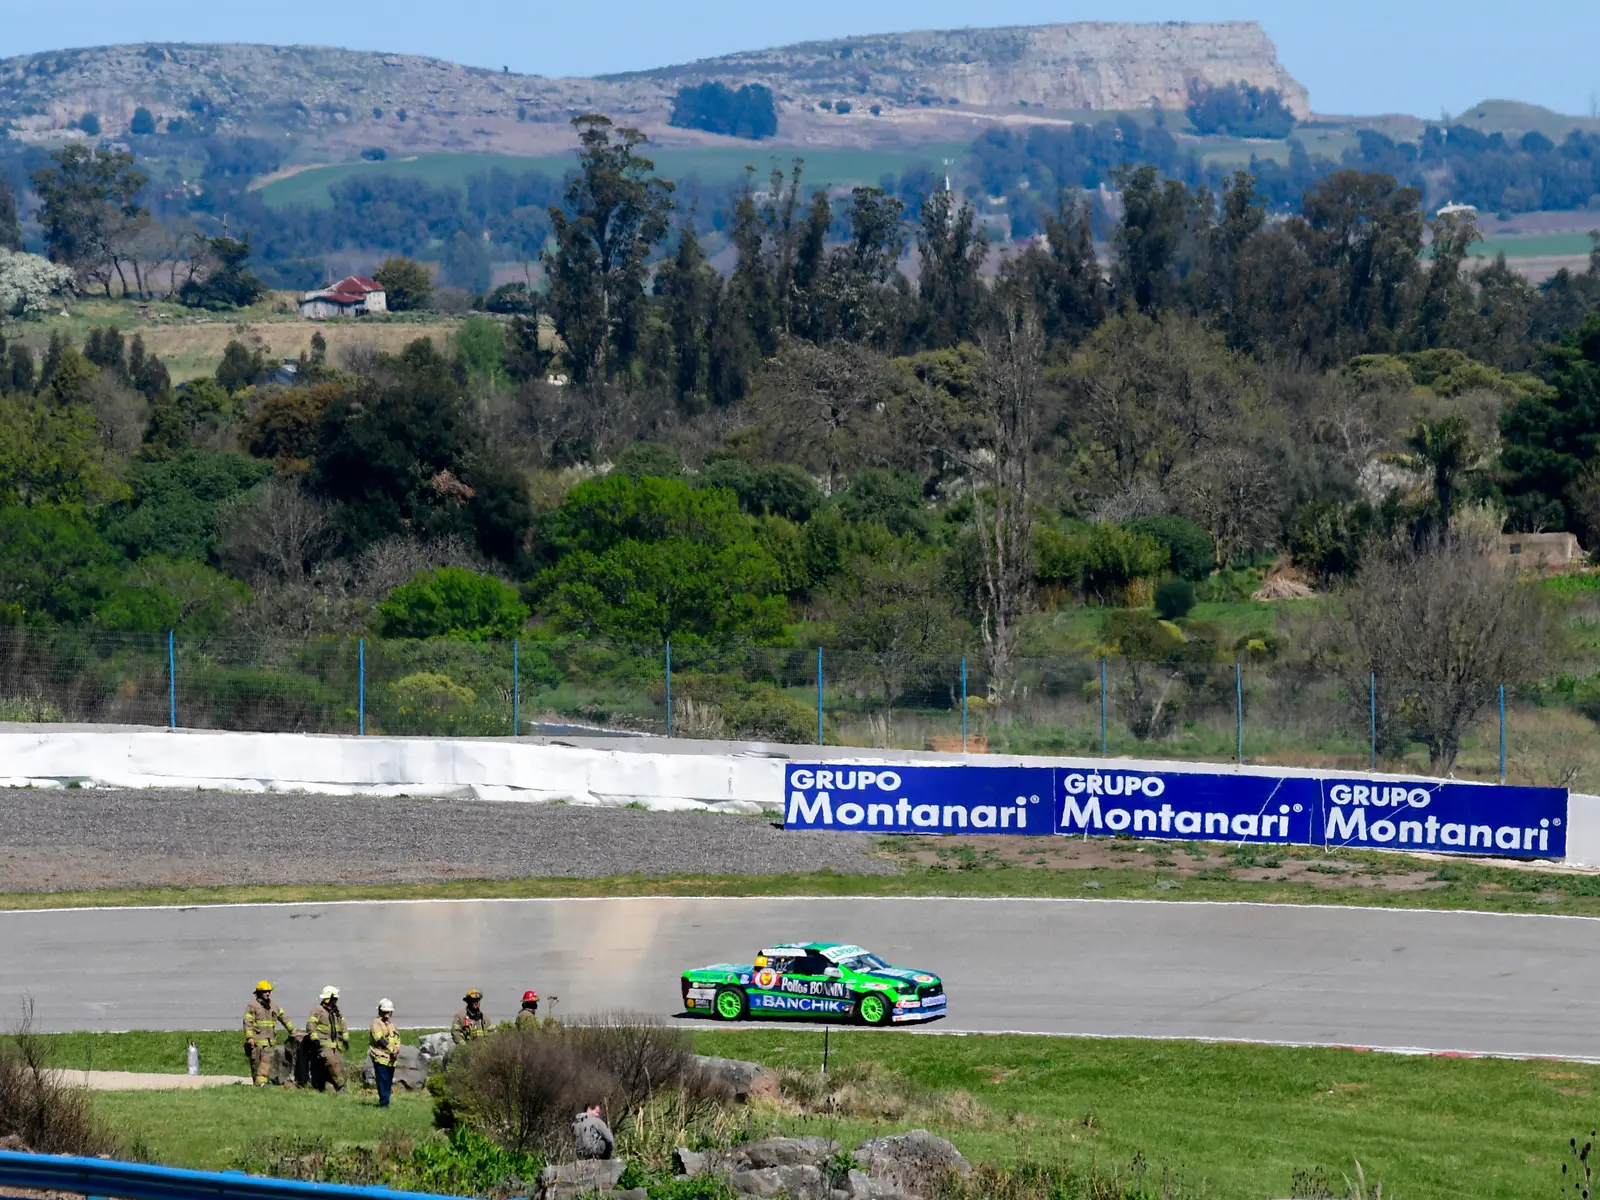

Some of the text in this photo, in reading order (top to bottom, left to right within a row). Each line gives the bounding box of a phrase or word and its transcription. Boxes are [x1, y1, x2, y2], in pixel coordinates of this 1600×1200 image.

[790, 770, 901, 791] GRUPO
[1065, 774, 1164, 796] GRUPO
[1330, 785, 1430, 808] GRUPO
[787, 791, 1027, 828] Montanari
[1061, 796, 1290, 837] Montanari
[1326, 807, 1549, 851] Montanari
[781, 977, 808, 994] Pollos
[763, 995, 840, 1012] BANCHIK
